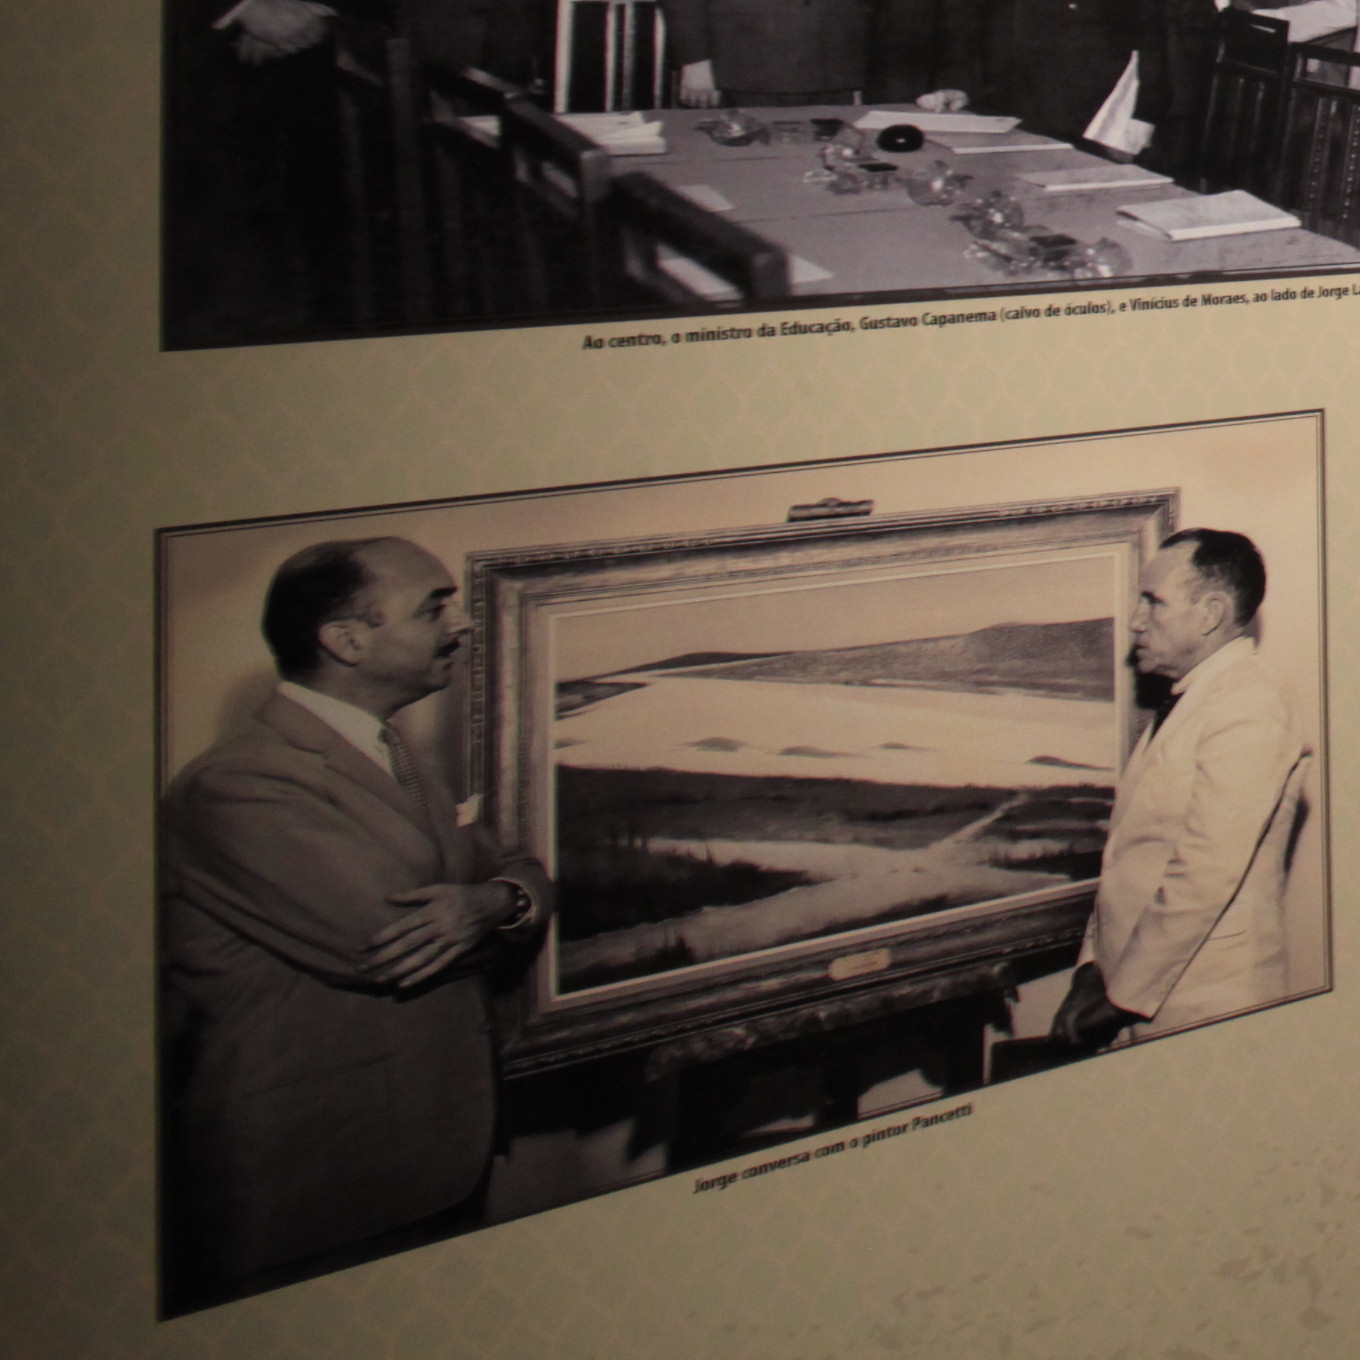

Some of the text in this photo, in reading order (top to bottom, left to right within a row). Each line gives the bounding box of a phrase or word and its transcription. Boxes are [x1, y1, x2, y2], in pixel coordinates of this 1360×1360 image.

[582, 334, 604, 350] Ao
[685, 326, 751, 343] ministro
[859, 315, 918, 331] Gustavo
[921, 310, 996, 328] Capanema
[1270, 288, 1296, 302] lado
[1317, 285, 1349, 300] Jorge
[692, 1171, 738, 1194] Jorge
[742, 1150, 811, 1180] conversa
[814, 1140, 846, 1158] com
[862, 1122, 910, 1148] pintor
